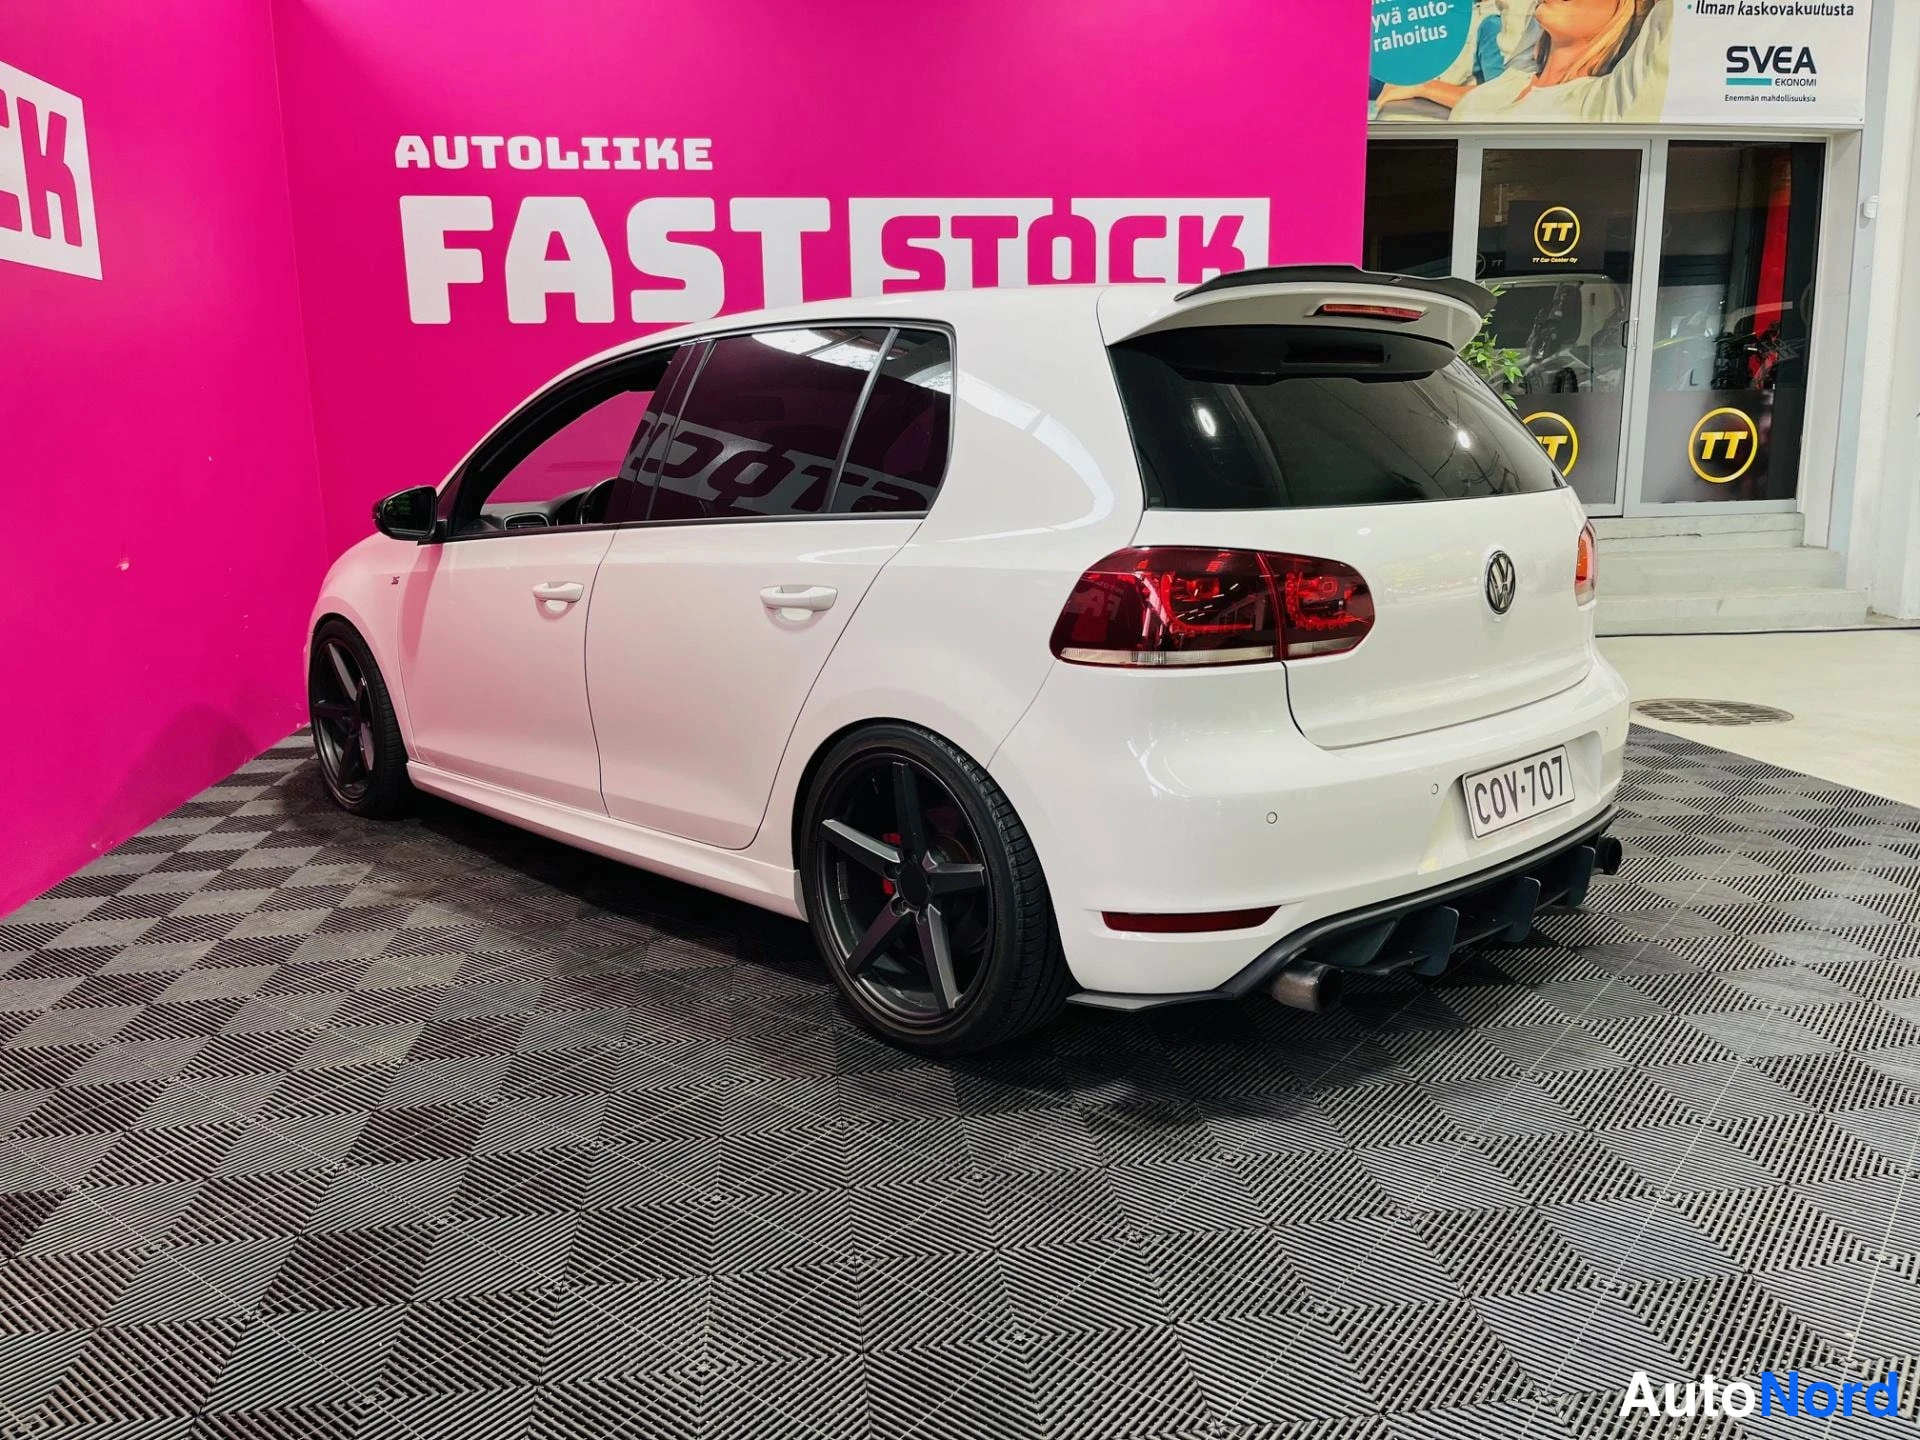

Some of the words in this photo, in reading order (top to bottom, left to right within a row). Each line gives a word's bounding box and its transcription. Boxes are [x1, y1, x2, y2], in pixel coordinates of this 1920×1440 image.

[1407, 1, 1455, 22] auto-
[1695, 0, 1735, 15] Ilman
[1738, 0, 1855, 16] kaskovakuutusta
[1373, 25, 1448, 53] rahoitus
[1726, 45, 1817, 74] SVEA
[1774, 78, 1817, 87] EKONOMI
[1724, 94, 1760, 102] Enemmän
[1760, 94, 1817, 103] mahdollisuuksia
[394, 135, 714, 171] AUTOLIIKE
[1541, 222, 1574, 242] TT
[399, 195, 832, 325] FAST
[880, 215, 1246, 295] STOCK
[1700, 430, 1749, 461] TT
[1474, 754, 1563, 826] COV-707
